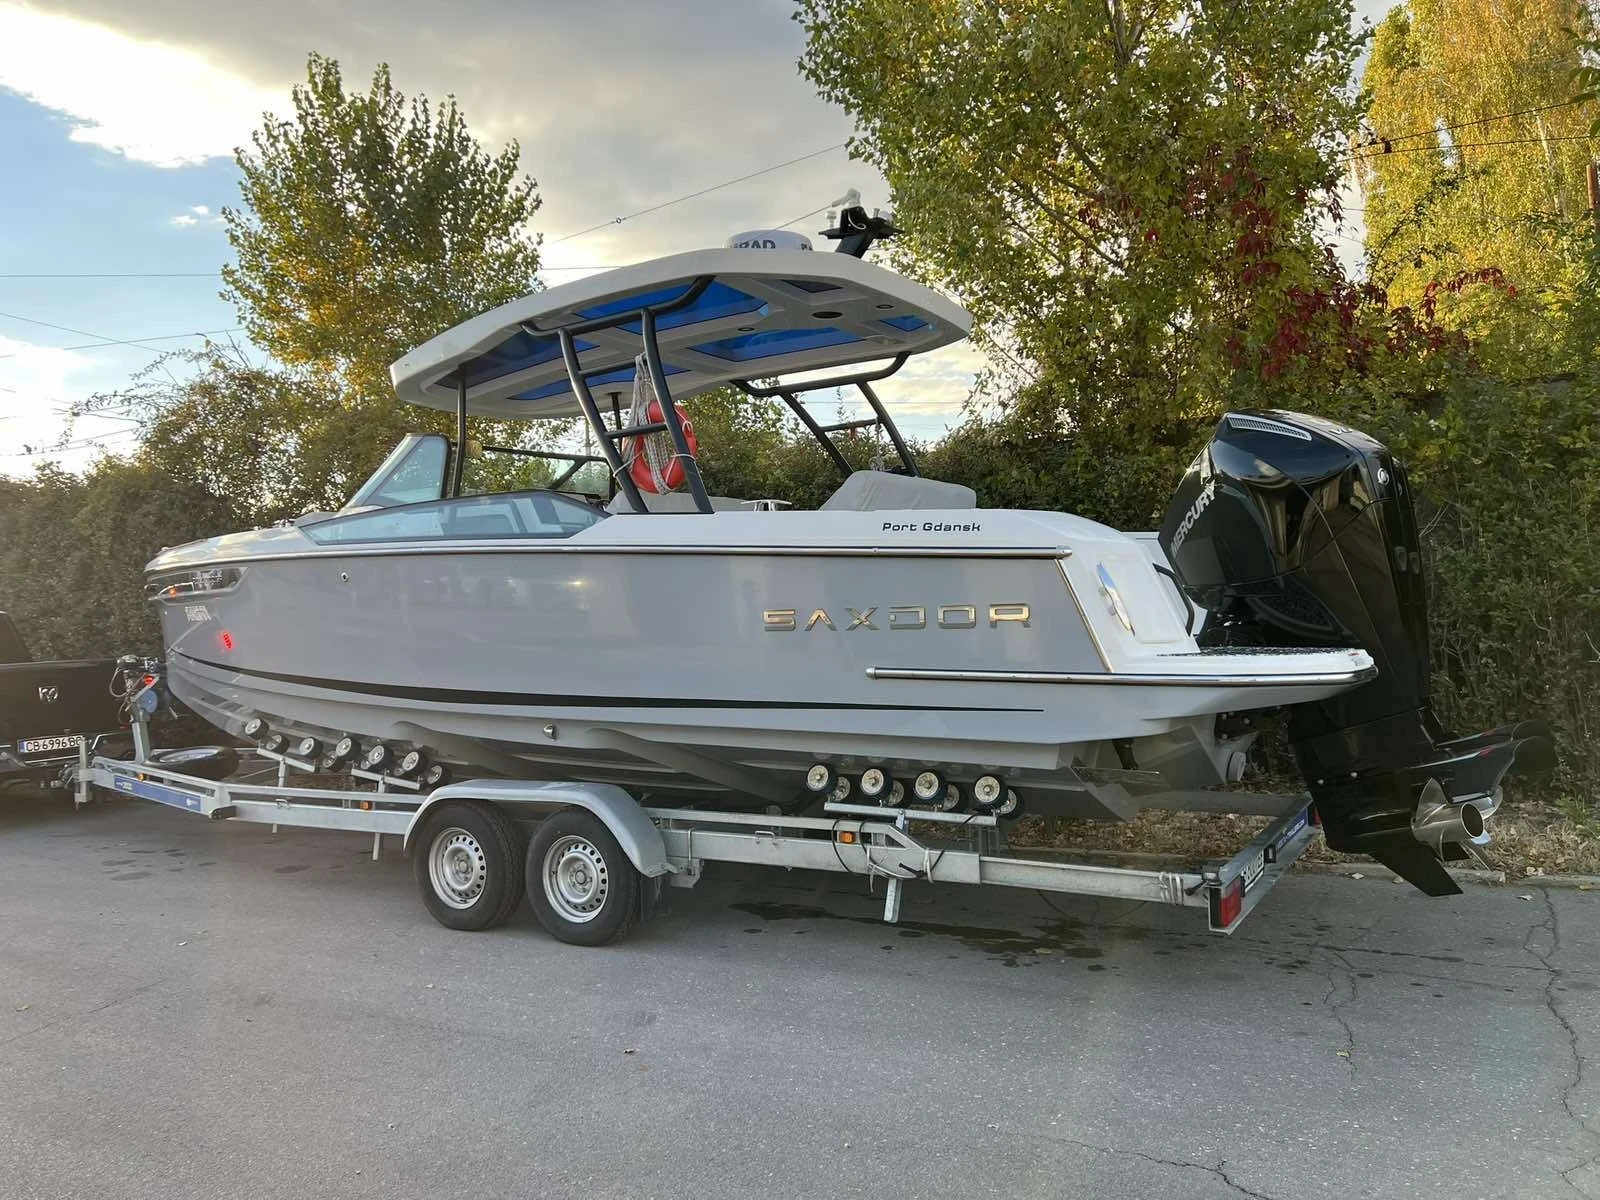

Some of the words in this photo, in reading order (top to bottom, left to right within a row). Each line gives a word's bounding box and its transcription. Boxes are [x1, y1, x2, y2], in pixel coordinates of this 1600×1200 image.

[881, 522, 917, 532] Port
[922, 522, 982, 532] Gdansk
[1170, 479, 1216, 559] MERCURY
[762, 602, 1032, 632] SAXDOR
